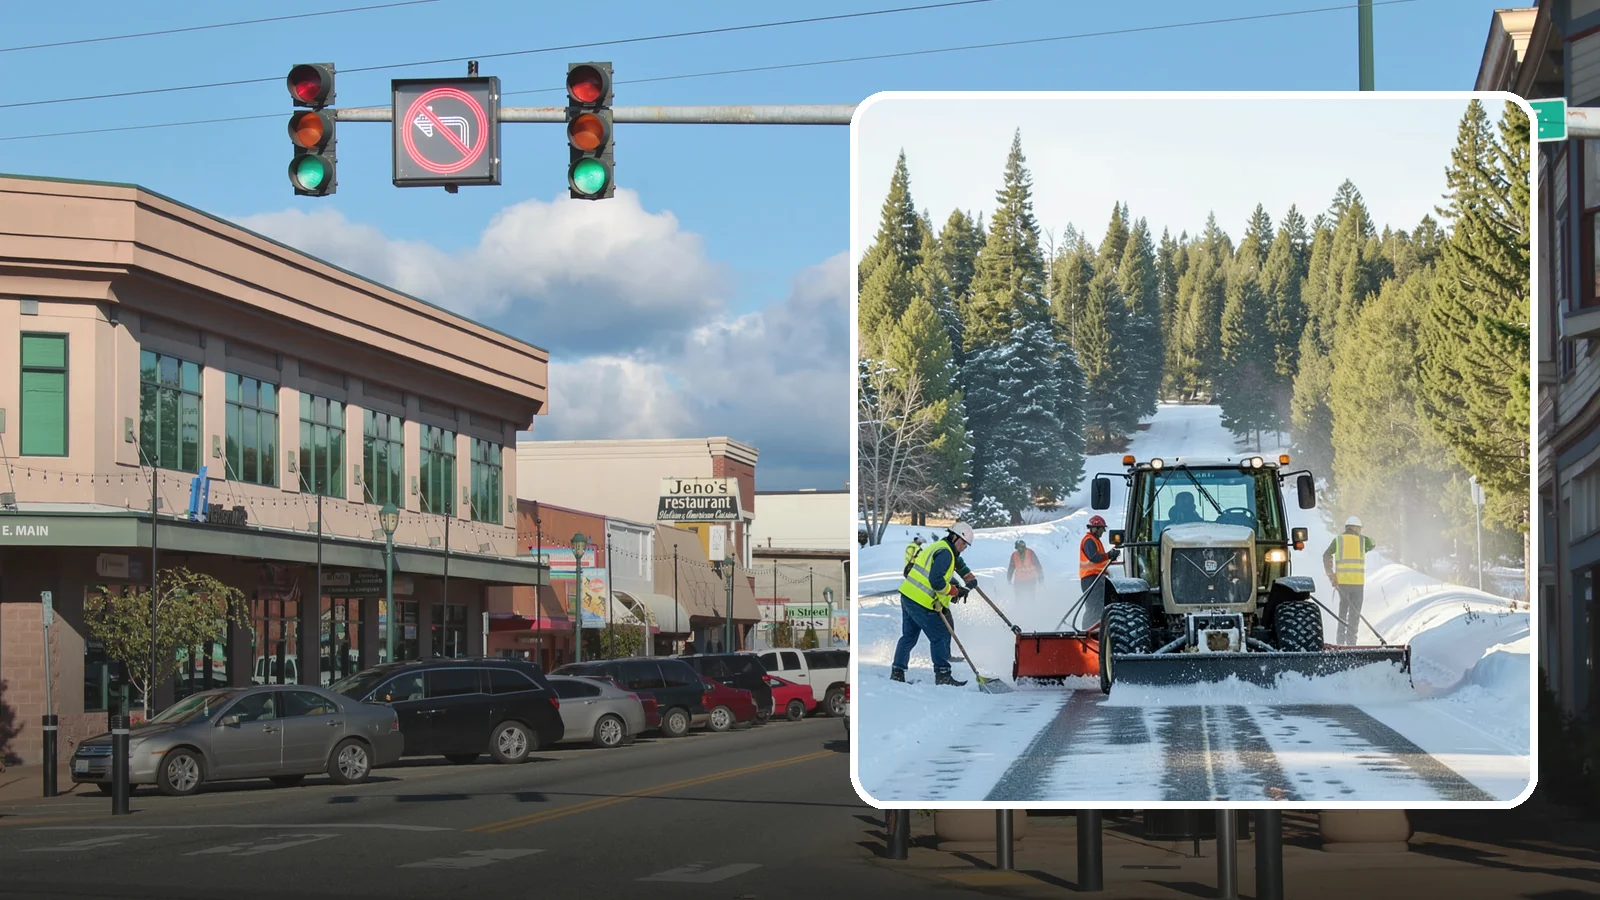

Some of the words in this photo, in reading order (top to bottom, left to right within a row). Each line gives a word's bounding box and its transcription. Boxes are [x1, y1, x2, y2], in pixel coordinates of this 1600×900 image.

[670, 480, 728, 495] Jeno's
[665, 496, 731, 509] restaurant
[659, 510, 682, 520] Italian
[686, 509, 715, 519] American
[715, 509, 737, 519] Cuisine
[2, 525, 13, 536] E.
[15, 525, 49, 536] MAIN
[797, 607, 829, 617] Street
